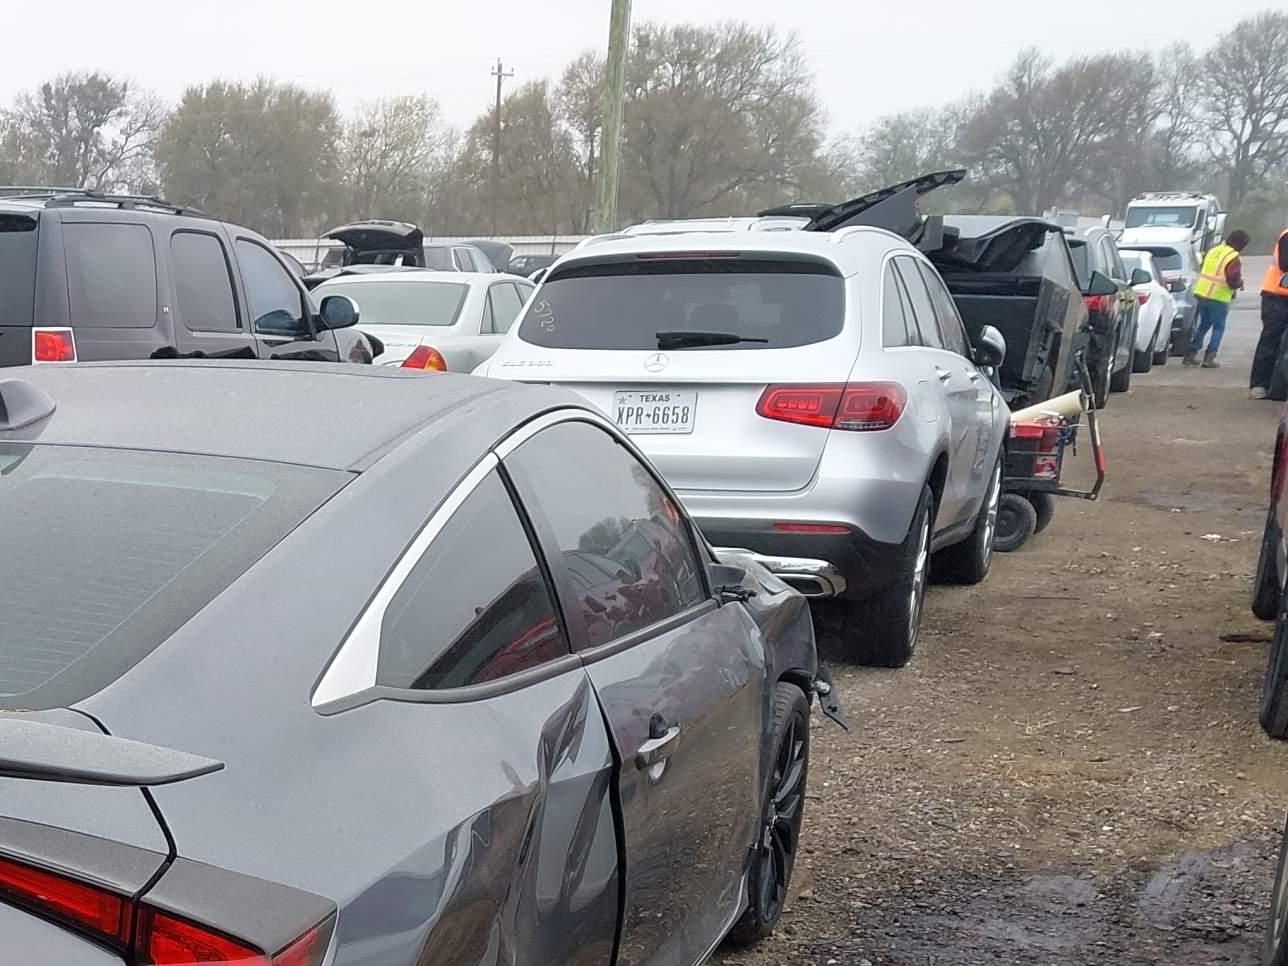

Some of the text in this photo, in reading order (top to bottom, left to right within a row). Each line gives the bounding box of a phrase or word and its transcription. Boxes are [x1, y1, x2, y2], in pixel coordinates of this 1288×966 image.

[639, 394, 671, 403] TEXAS
[616, 405, 690, 425] XPR 6658
